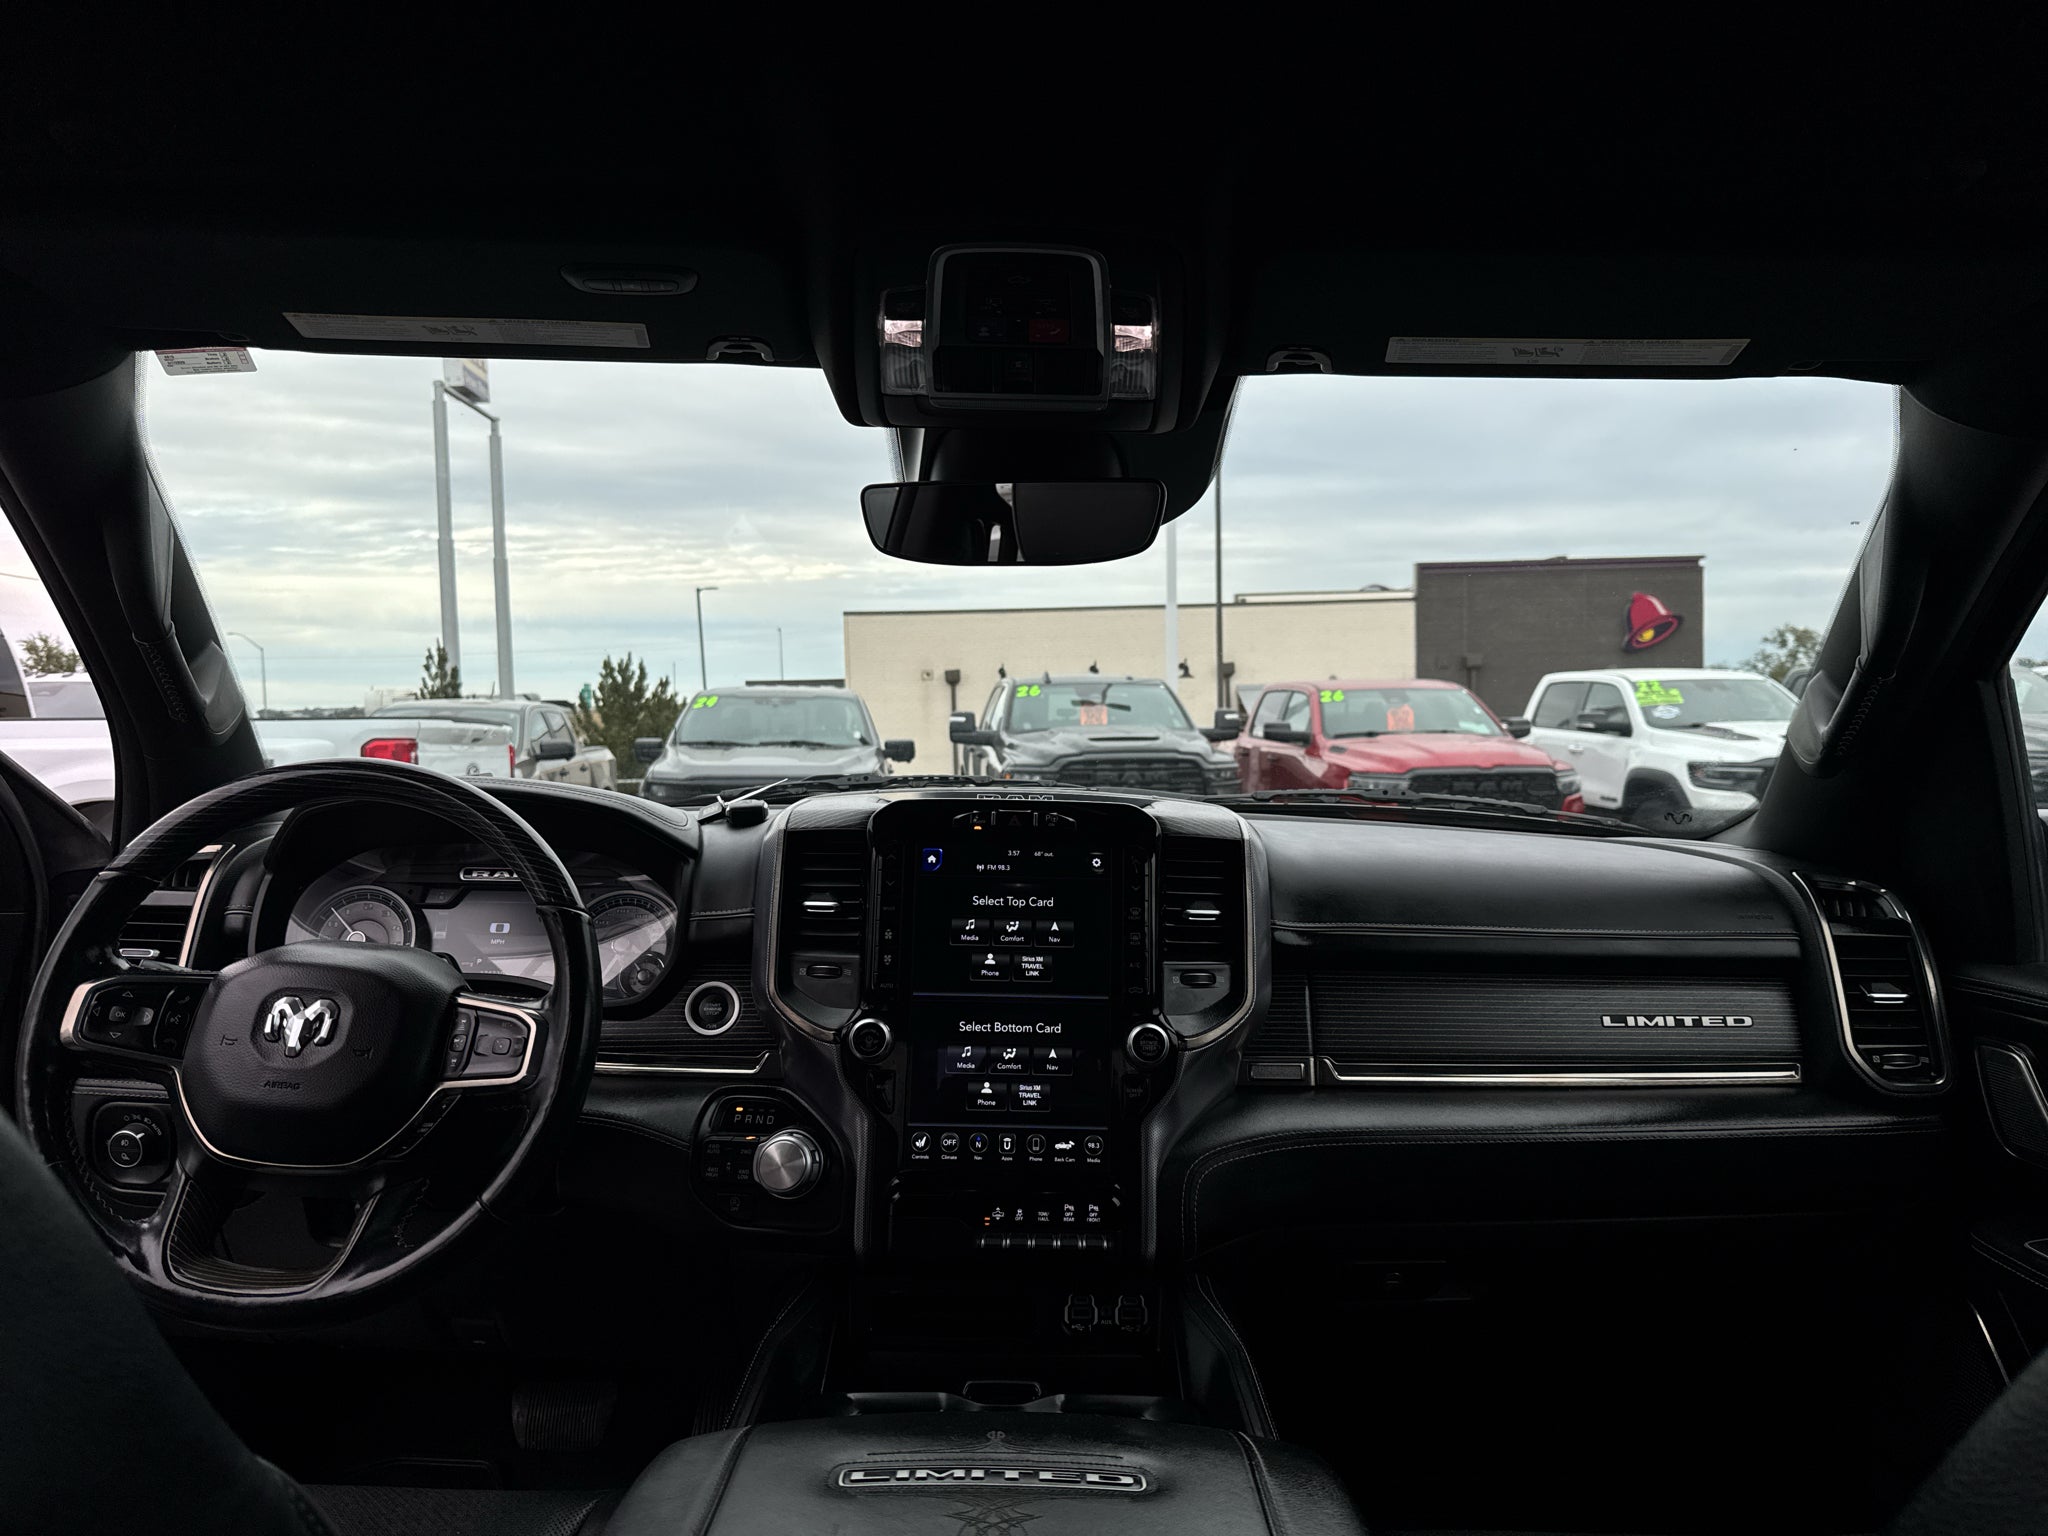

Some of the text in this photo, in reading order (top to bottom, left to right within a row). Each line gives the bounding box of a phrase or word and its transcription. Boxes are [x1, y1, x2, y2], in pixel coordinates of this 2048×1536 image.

[1016, 685, 1041, 698] 26
[1320, 689, 1345, 703] 26
[471, 870, 519, 879] RA
[972, 895, 1055, 908] Select Top Card
[489, 922, 511, 934] 0
[960, 934, 980, 942] Media
[1000, 935, 1025, 943] Comfort
[1048, 936, 1061, 944] Nav
[980, 969, 1000, 977] Phone
[1601, 1015, 1754, 1028] LIMITED
[958, 1020, 1062, 1034] Select Bottom Card
[956, 1062, 976, 1070] Media
[996, 1062, 1023, 1071] Comfort
[1018, 1091, 1042, 1099] TRAVEL
[976, 1098, 997, 1107] Phone
[1022, 1099, 1038, 1107] LINK
[942, 1138, 957, 1147] OFF
[975, 1142, 982, 1150] N
[1087, 1141, 1100, 1149] 98.3
[849, 1470, 1135, 1486] LIMITED
